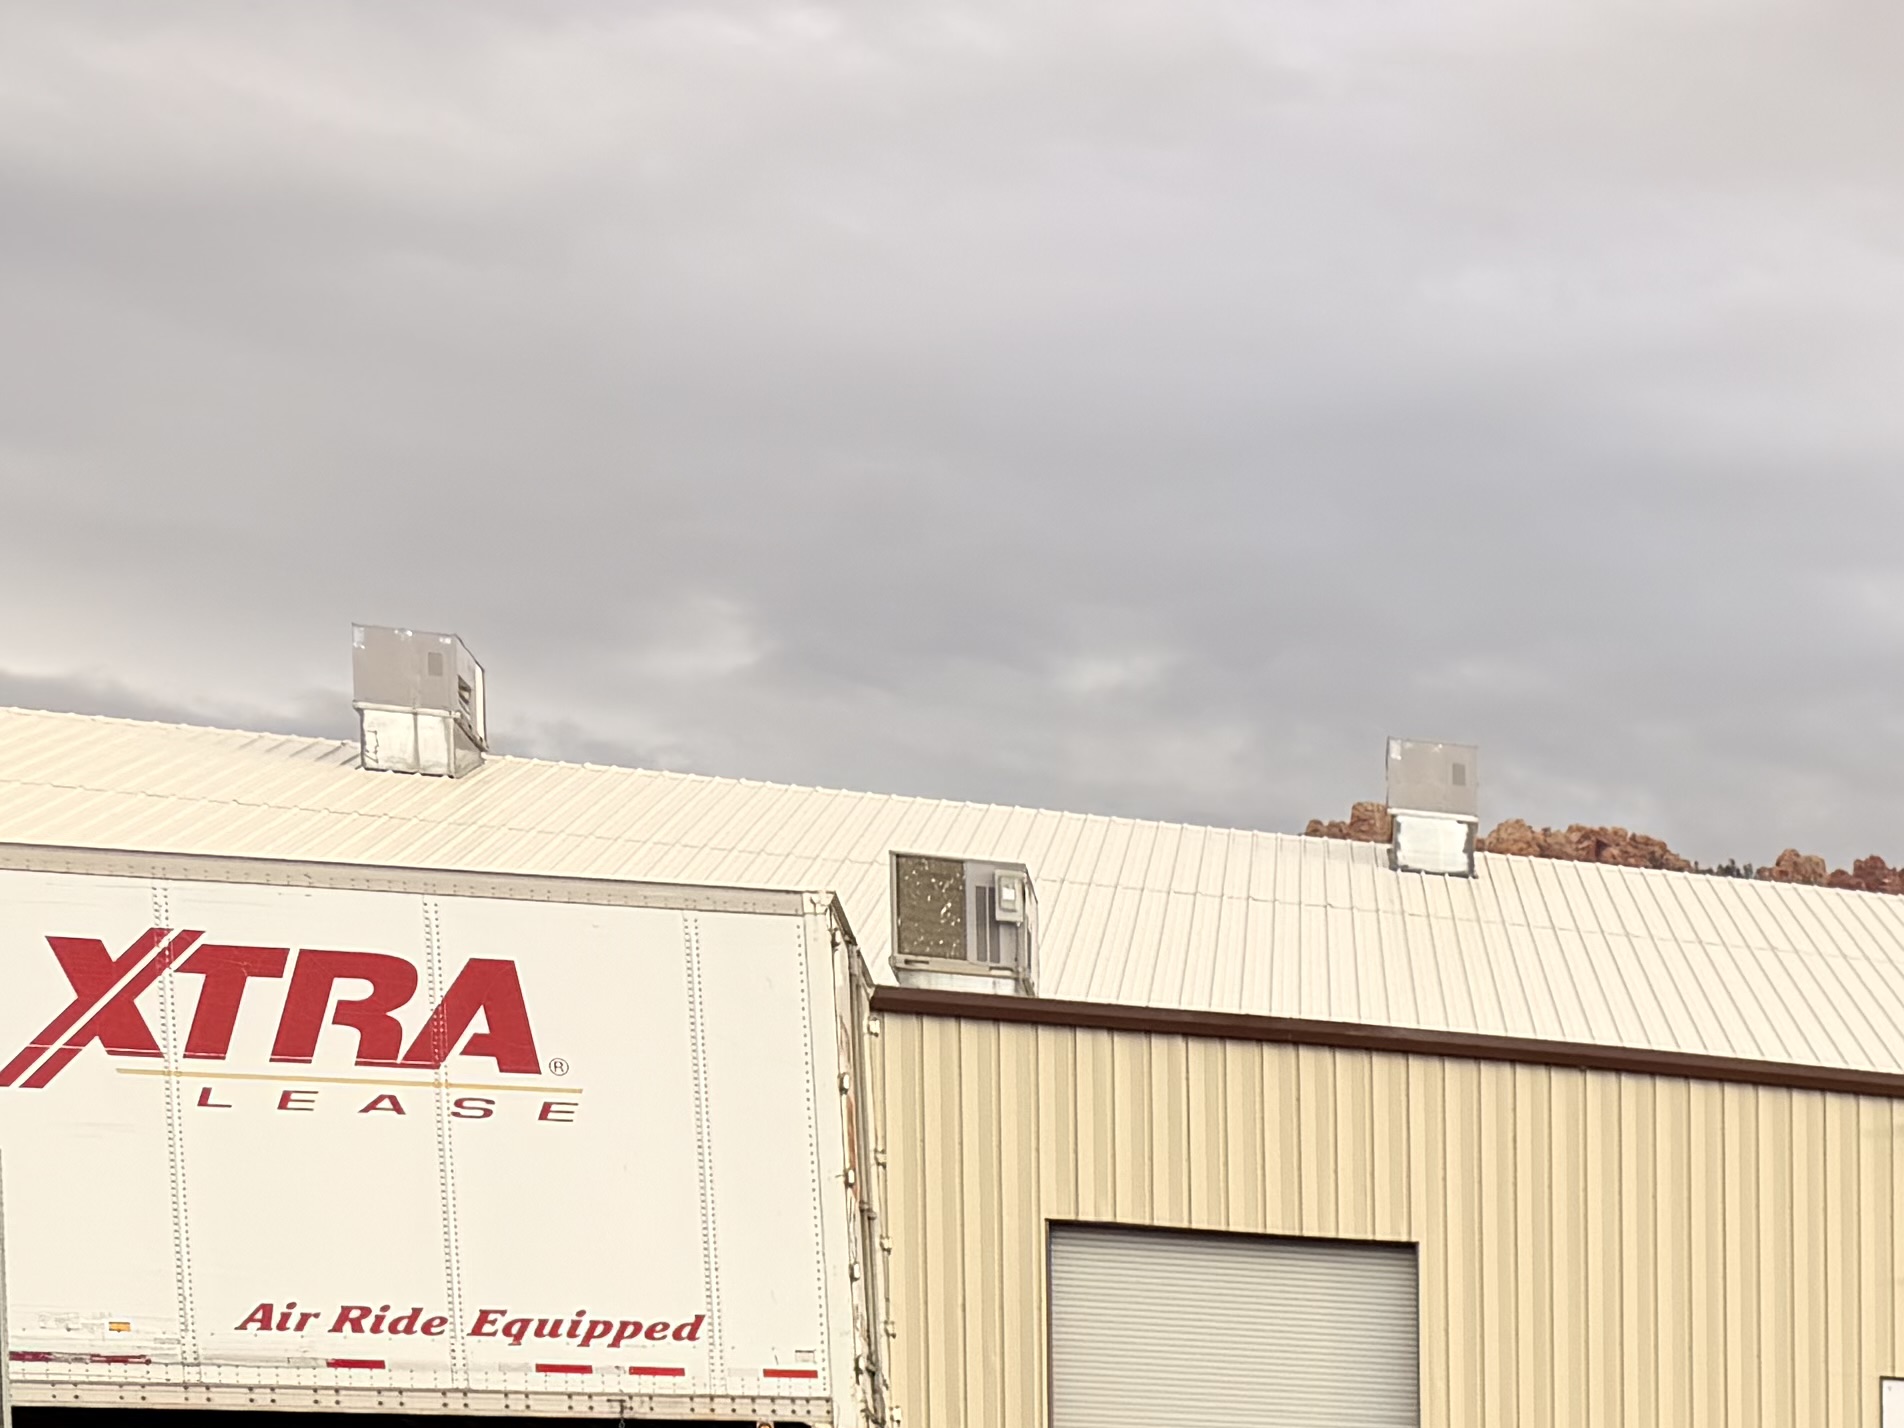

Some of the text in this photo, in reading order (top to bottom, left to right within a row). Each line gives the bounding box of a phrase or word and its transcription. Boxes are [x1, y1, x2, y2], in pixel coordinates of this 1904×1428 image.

[0, 927, 542, 1088] XTRA
[196, 1086, 579, 1123] LEASE
[235, 1302, 706, 1348] Air Ride Equipped
